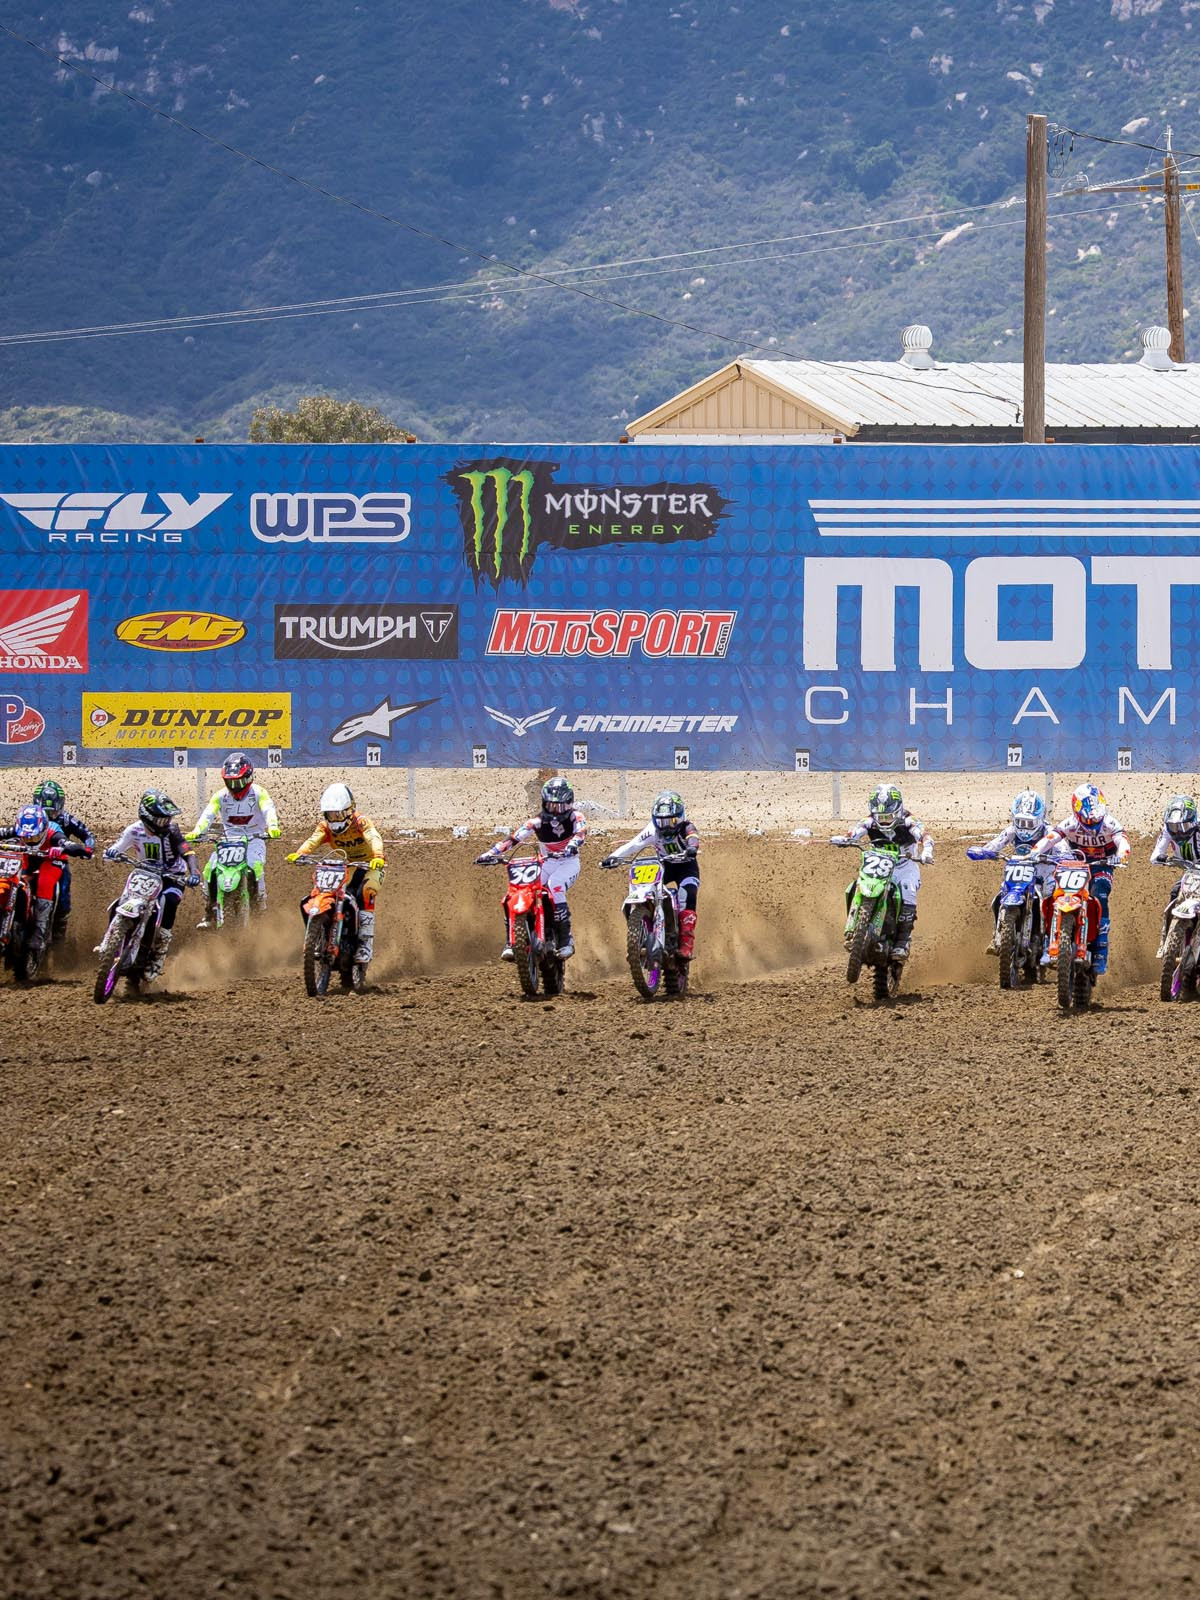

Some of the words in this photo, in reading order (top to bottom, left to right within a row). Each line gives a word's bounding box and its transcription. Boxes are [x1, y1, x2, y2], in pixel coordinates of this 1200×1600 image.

[545, 489, 713, 519] MONSTER
[0, 493, 233, 530] FLY
[250, 492, 412, 543] WPS
[569, 525, 685, 535] ENERGY
[49, 533, 182, 543] RACING
[118, 616, 243, 641] FMF
[280, 616, 417, 646] TRIUMPH
[0, 655, 83, 669] HONDA
[120, 709, 283, 727] DUNLOP
[555, 715, 739, 733] LANDMASTER
[11, 721, 42, 738] Racing
[116, 729, 215, 740] MOTORCYCLE
[224, 729, 269, 740] TIRES
[178, 756, 184, 765] 9
[269, 754, 281, 763] 10
[368, 752, 379, 761] 11
[475, 754, 485, 763] 12
[575, 751, 585, 760] 13
[676, 756, 687, 765] 14
[906, 757, 917, 766] 16
[1009, 753, 1020, 762] 17
[1119, 757, 1130, 766] 18
[797, 758, 808, 767] 15
[225, 803, 256, 814] FLY
[1075, 835, 1107, 846] THOR
[218, 847, 246, 864] 378
[863, 856, 893, 877] 29
[509, 865, 540, 885] 30
[632, 864, 660, 885] 38
[1005, 866, 1034, 882] 705
[1057, 870, 1087, 889] 16
